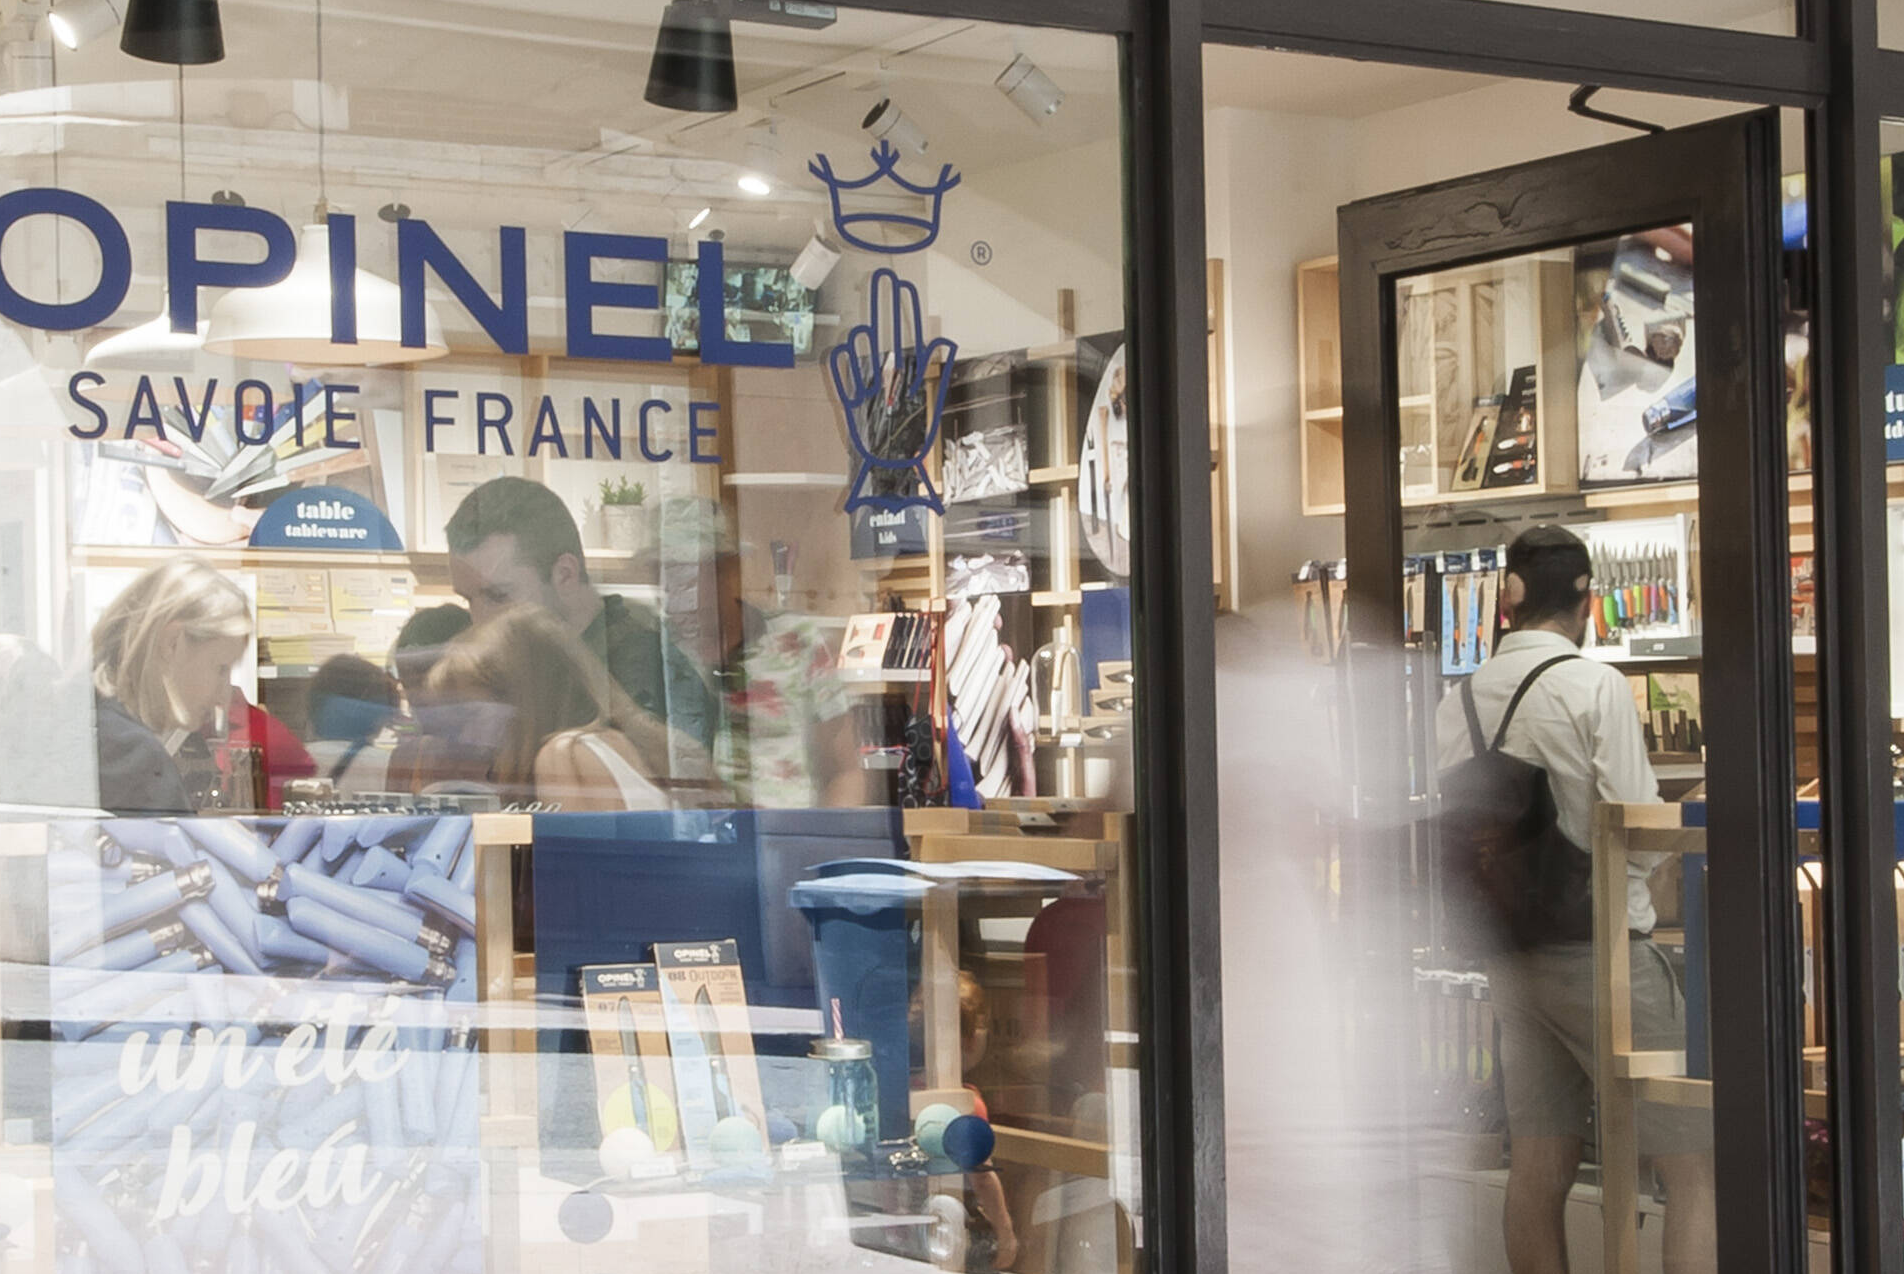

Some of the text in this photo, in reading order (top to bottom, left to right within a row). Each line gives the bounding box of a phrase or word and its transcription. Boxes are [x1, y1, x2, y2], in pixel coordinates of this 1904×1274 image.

[67, 370, 724, 465] SAVOIE FRANCE
[296, 500, 355, 520] table
[284, 523, 368, 540] tableware
